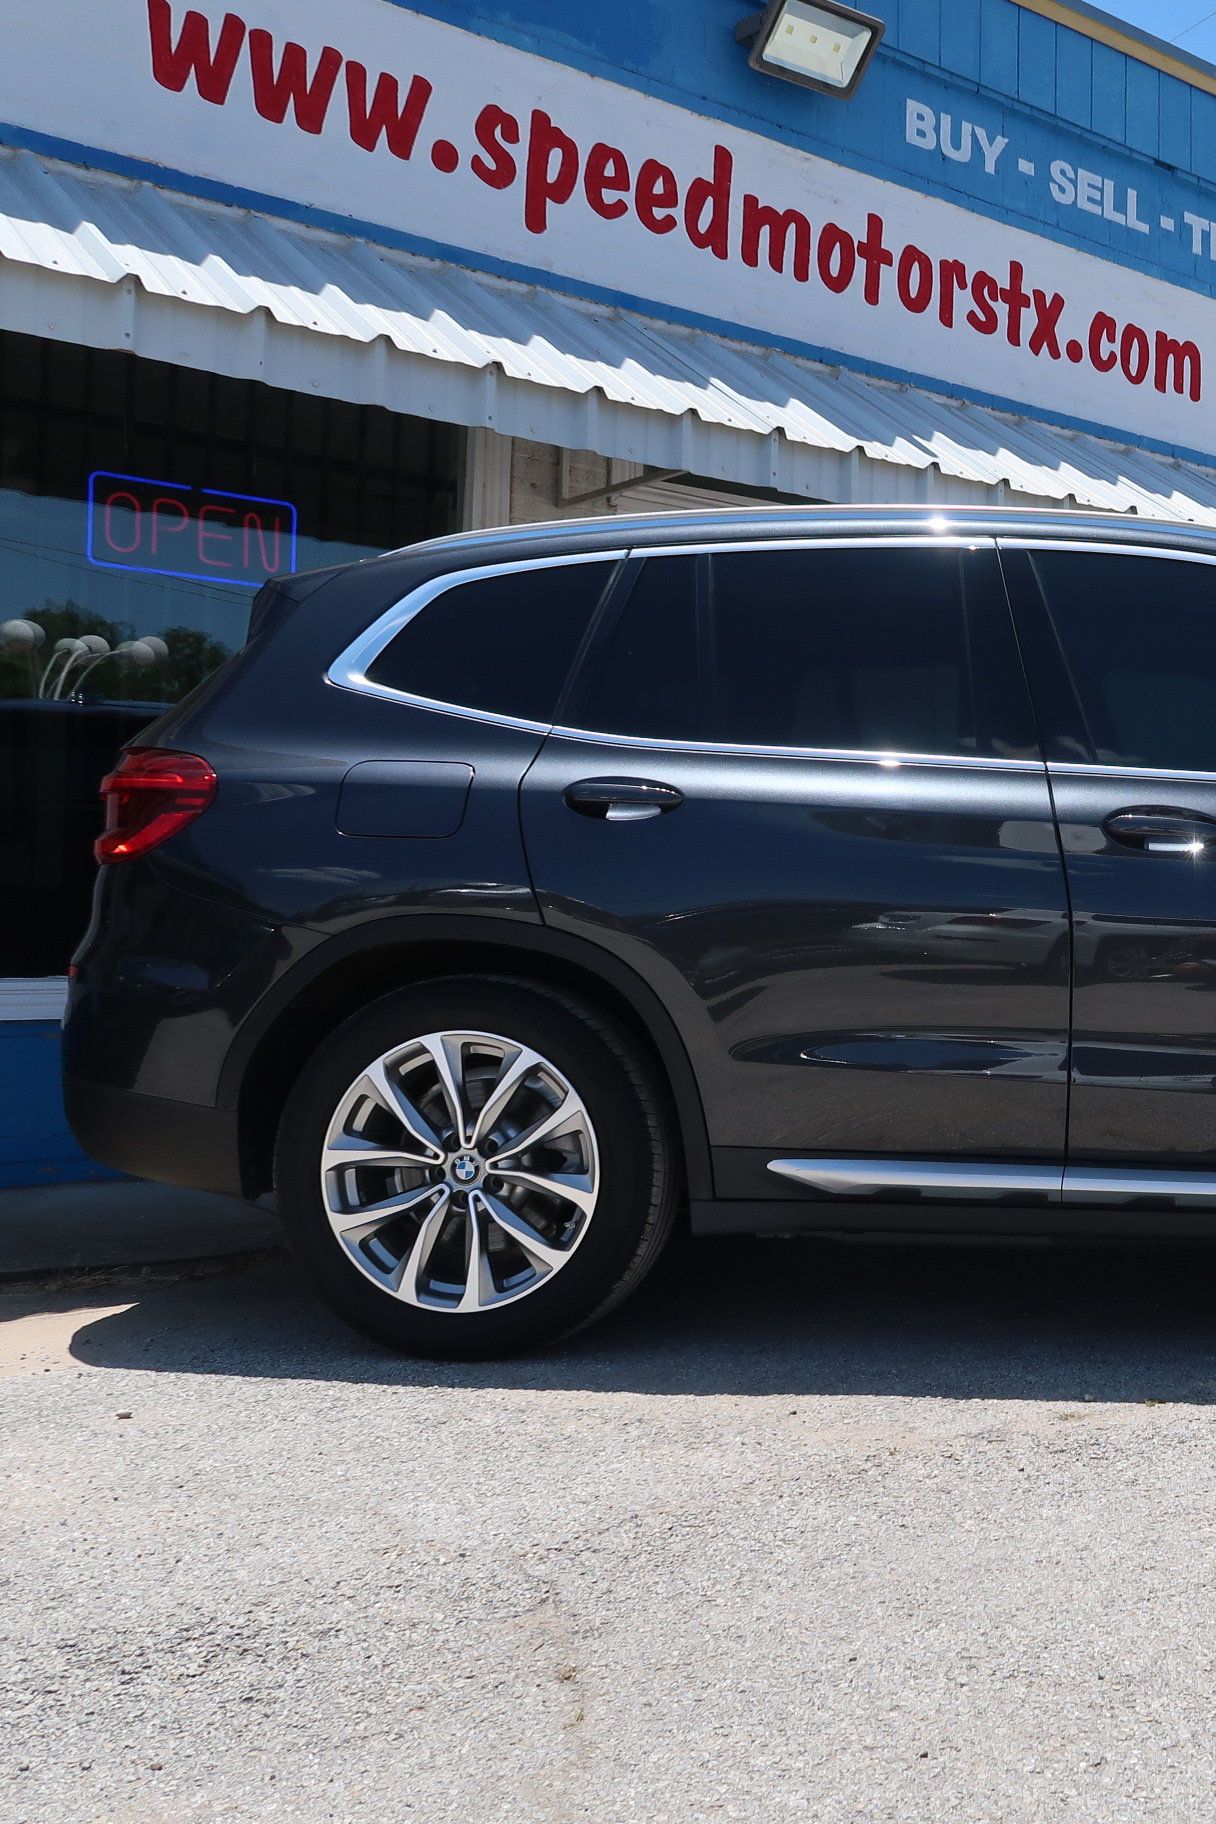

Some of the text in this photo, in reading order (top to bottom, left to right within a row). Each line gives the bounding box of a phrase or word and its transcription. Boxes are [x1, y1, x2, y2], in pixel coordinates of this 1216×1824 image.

[148, 0, 1201, 401] www.speedmotorstx.com
[905, 98, 1009, 175] BUY
[1048, 160, 1150, 234] SELL
[104, 491, 281, 573] OPEN
